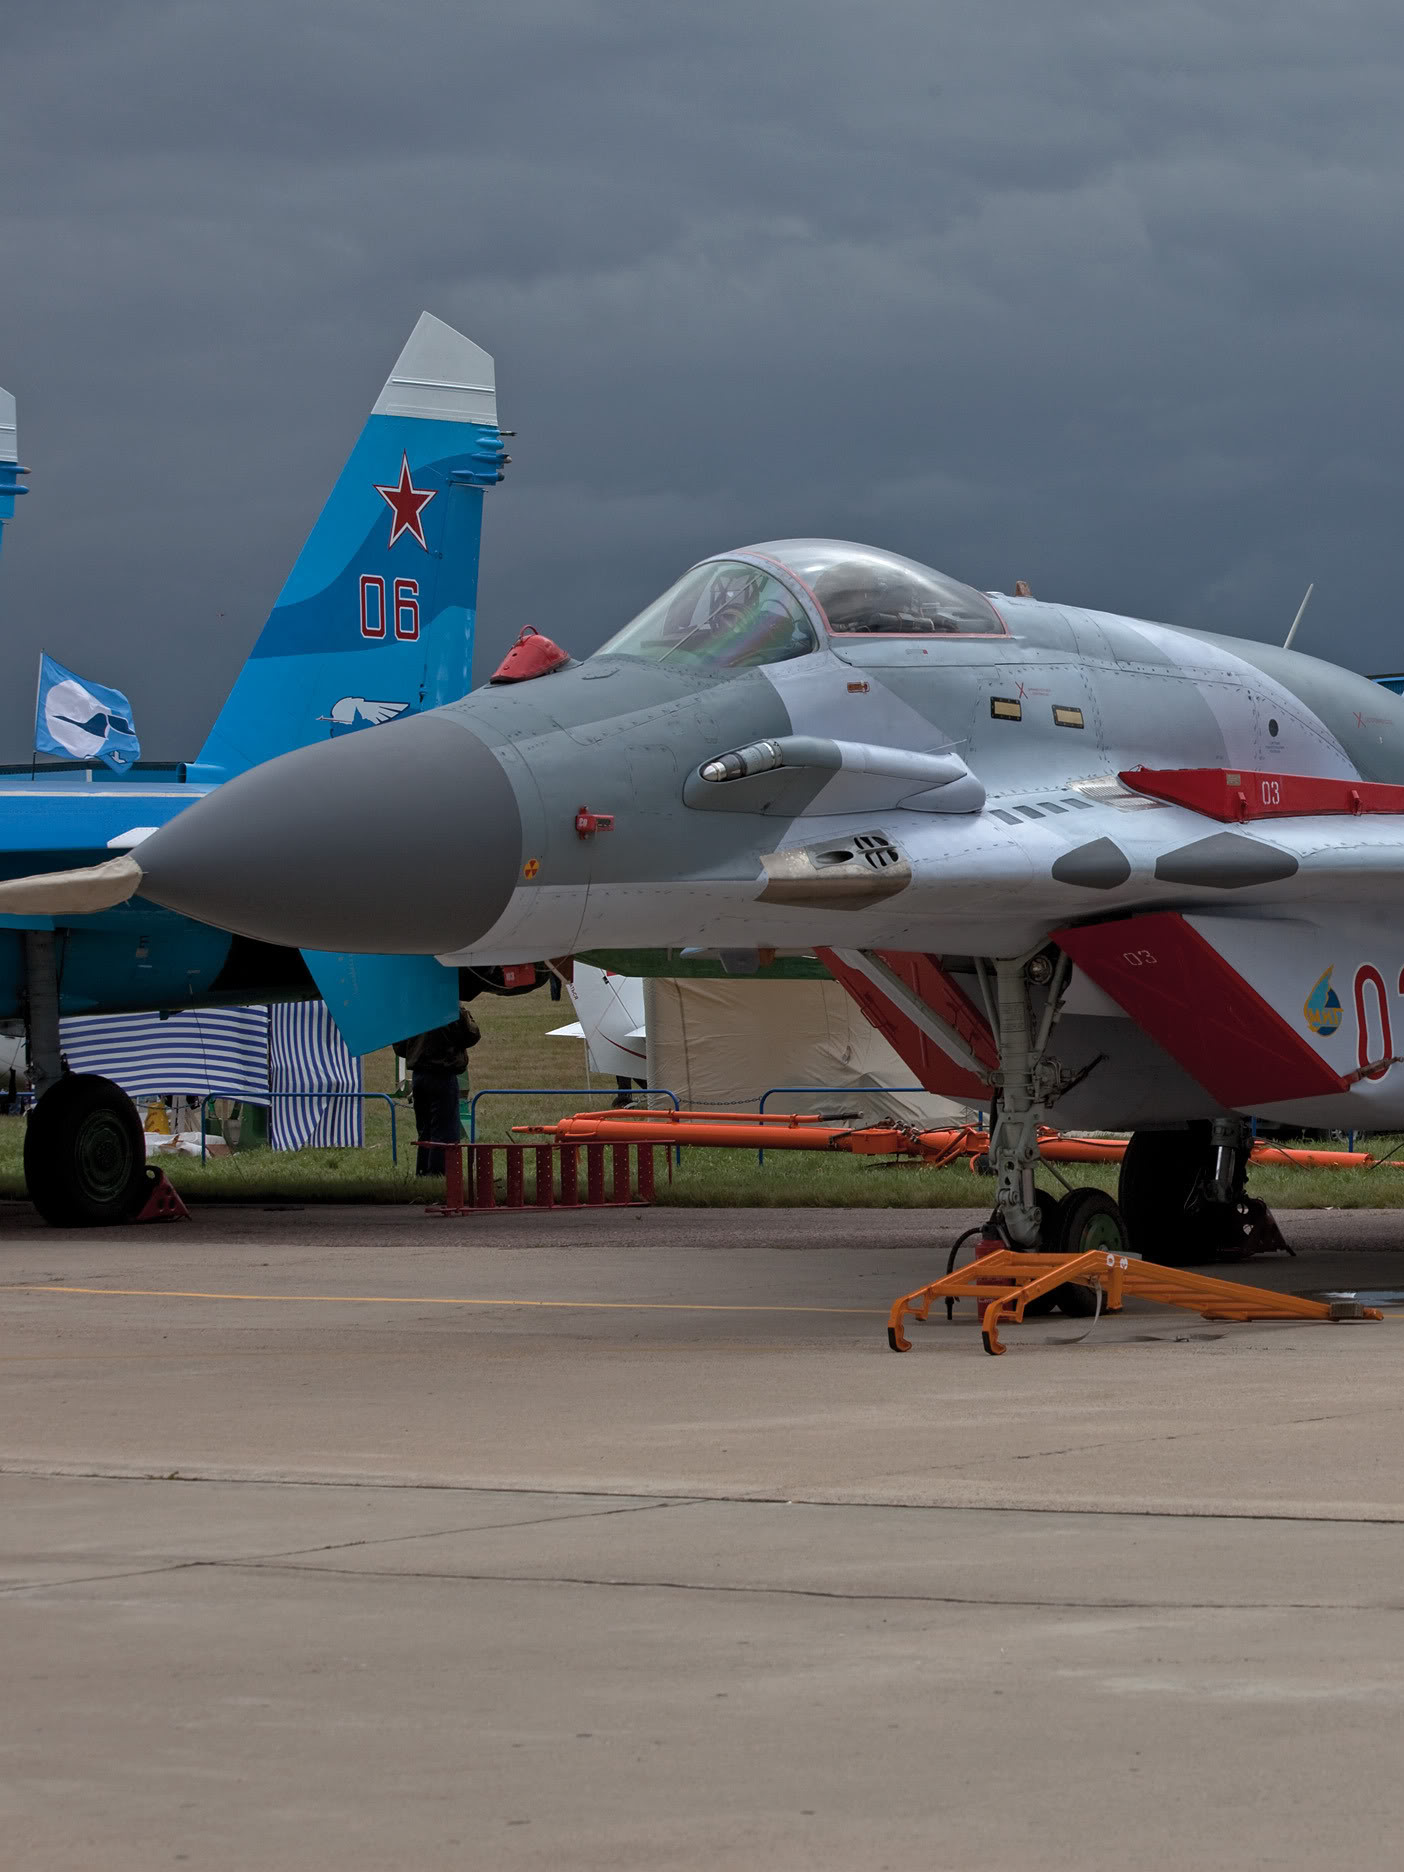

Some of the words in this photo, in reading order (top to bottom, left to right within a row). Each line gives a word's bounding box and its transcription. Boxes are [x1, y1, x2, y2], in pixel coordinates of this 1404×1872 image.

[359, 573, 420, 642] 06
[1261, 781, 1280, 805] 03
[1123, 949, 1158, 966] 03
